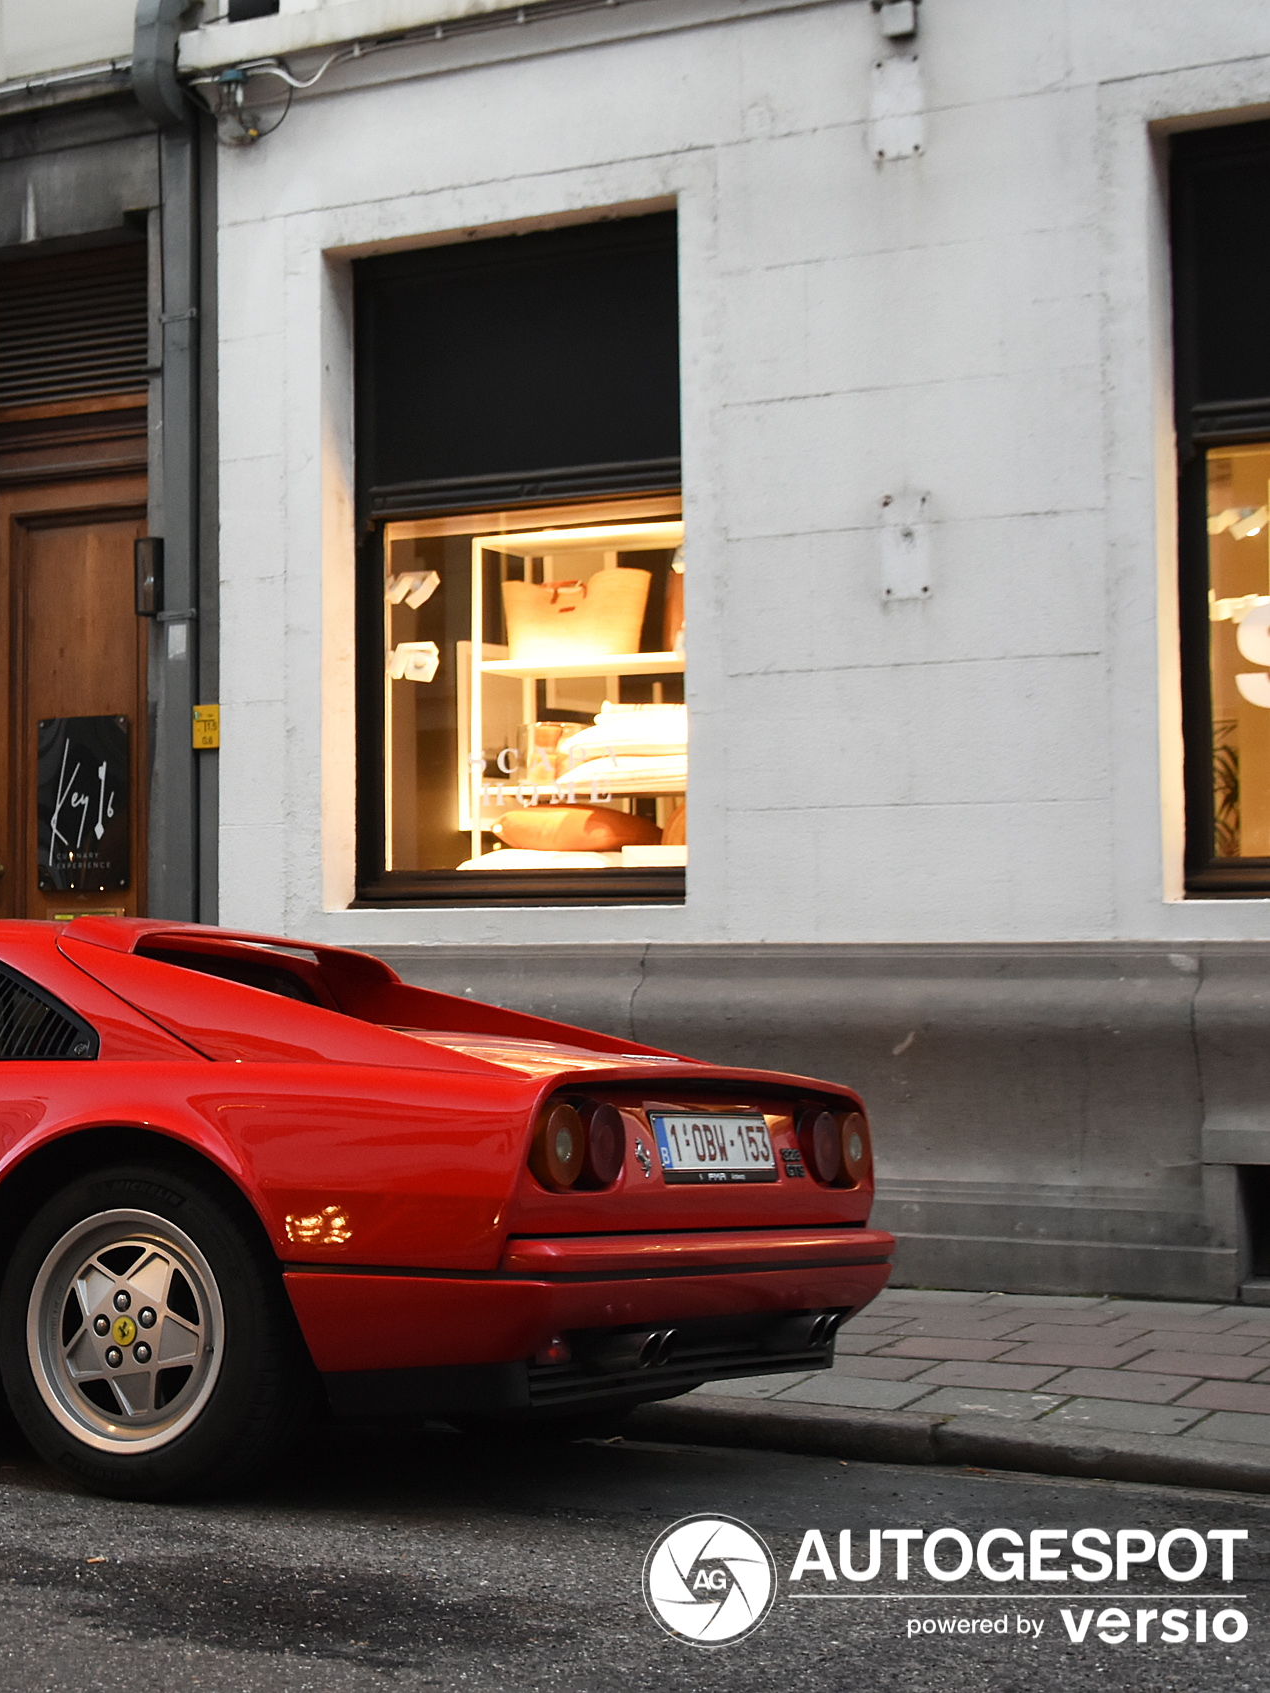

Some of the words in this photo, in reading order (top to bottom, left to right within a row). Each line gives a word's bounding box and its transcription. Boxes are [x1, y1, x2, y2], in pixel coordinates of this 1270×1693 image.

[482, 779, 613, 806] HOME
[56, 861, 111, 870] EXPERIENCE
[660, 1147, 671, 1164] B
[785, 1164, 806, 1178] GTS
